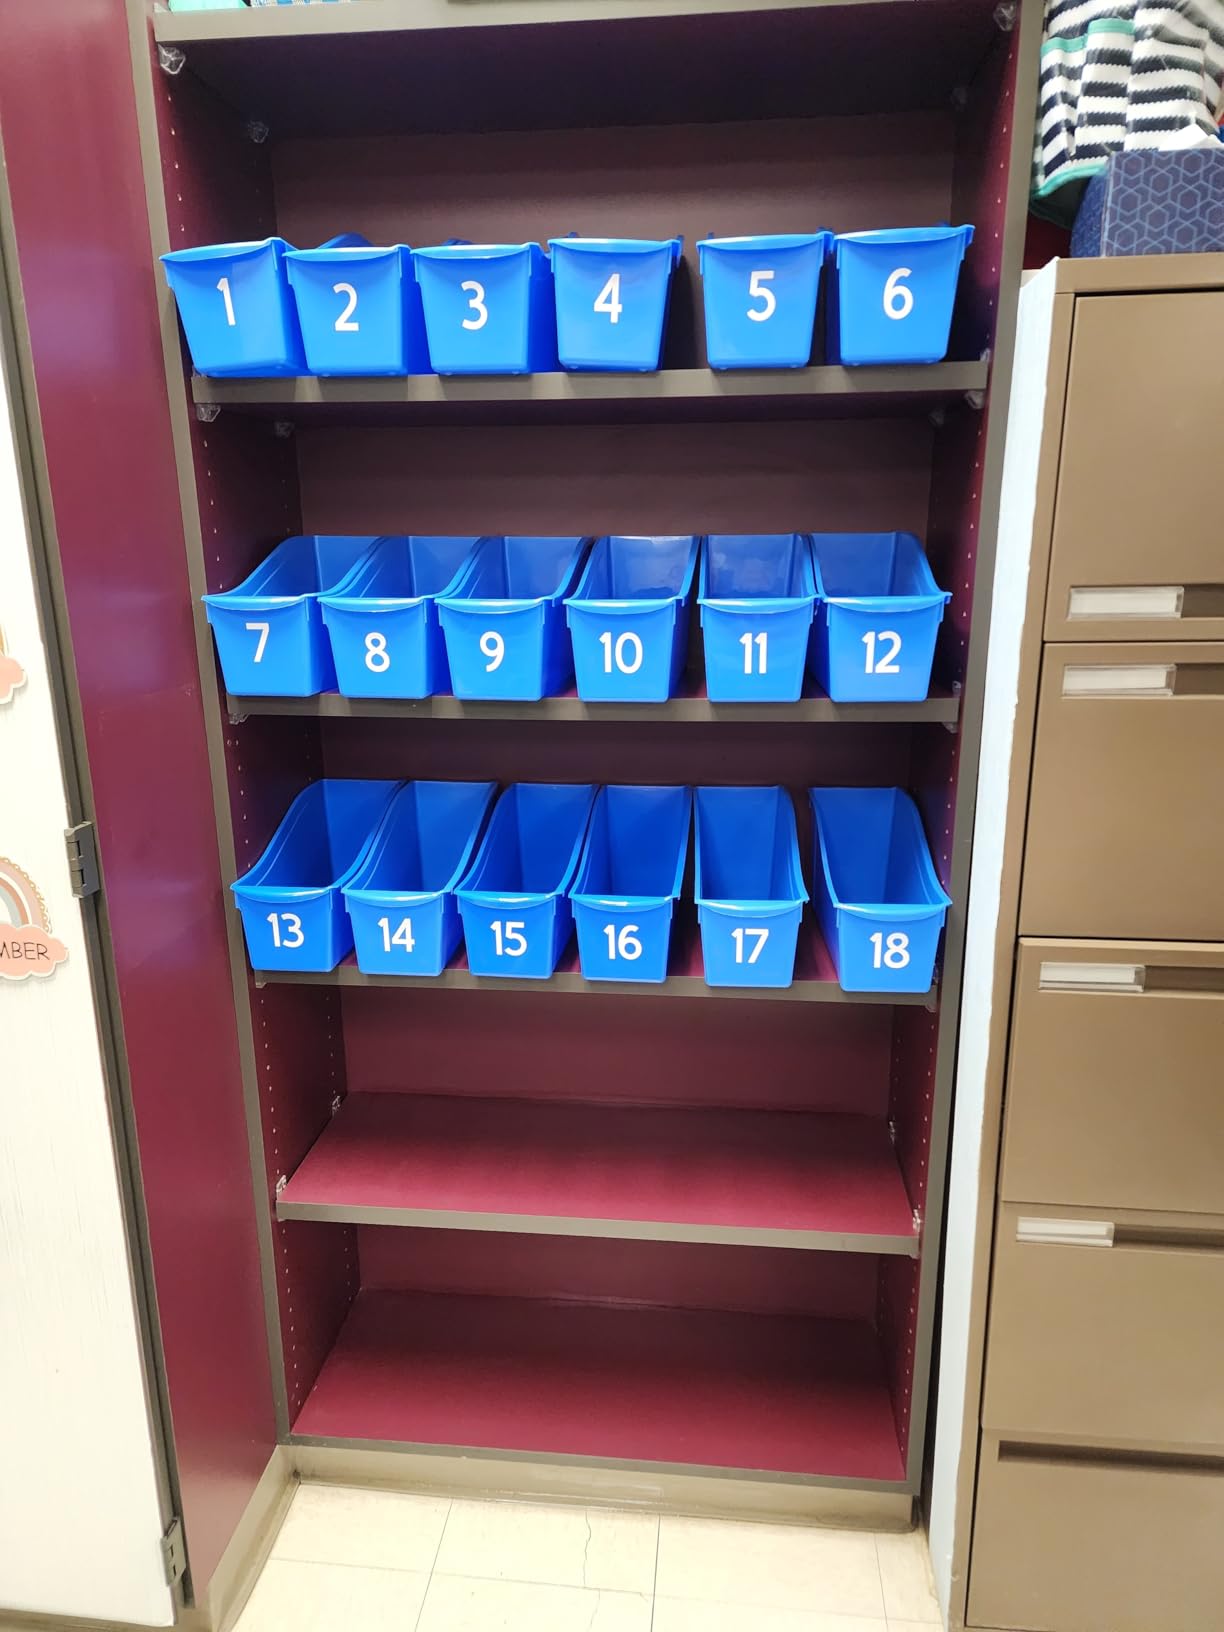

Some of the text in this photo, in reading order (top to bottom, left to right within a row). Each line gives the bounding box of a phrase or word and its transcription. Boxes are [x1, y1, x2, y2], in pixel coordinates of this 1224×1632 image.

[217, 277, 236, 326] 1
[333, 282, 360, 332] 2
[461, 280, 488, 330] 3
[593, 273, 623, 324] 4
[747, 270, 776, 322] 5
[883, 267, 914, 320] 6
[245, 622, 270, 663] 7
[364, 632, 390, 673] 8
[480, 631, 505, 672] 9
[600, 632, 643, 674] 10
[739, 632, 768, 674] 11
[862, 631, 902, 674] 12
[267, 913, 305, 948] 13
[378, 917, 415, 953] 14
[490, 921, 528, 956] 15
[603, 924, 643, 960] 16
[731, 928, 769, 964] 17
[870, 932, 910, 969] 18
